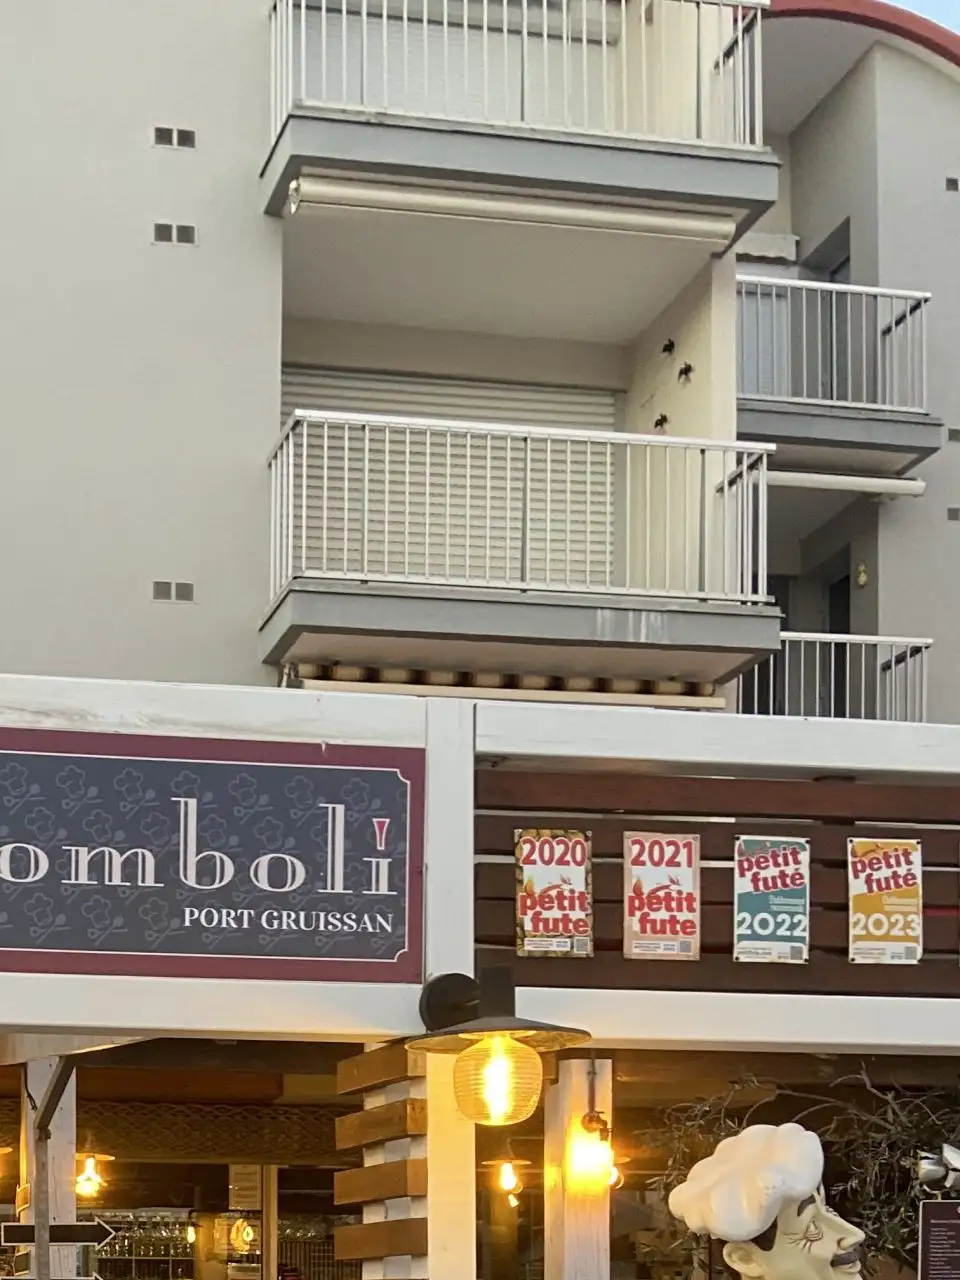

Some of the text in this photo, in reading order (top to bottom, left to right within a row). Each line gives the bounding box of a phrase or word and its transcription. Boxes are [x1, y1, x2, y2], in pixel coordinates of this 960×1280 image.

[521, 838, 587, 866] 2020
[630, 839, 693, 867] 2021
[737, 846, 802, 878] petit
[851, 848, 913, 879] petit
[751, 868, 805, 893] futé
[864, 868, 918, 894] futé
[520, 889, 589, 916] petit
[628, 889, 697, 916] petit
[183, 907, 393, 933] PORT GRUISSAN
[736, 912, 807, 935] 2022
[852, 913, 920, 935] 2023
